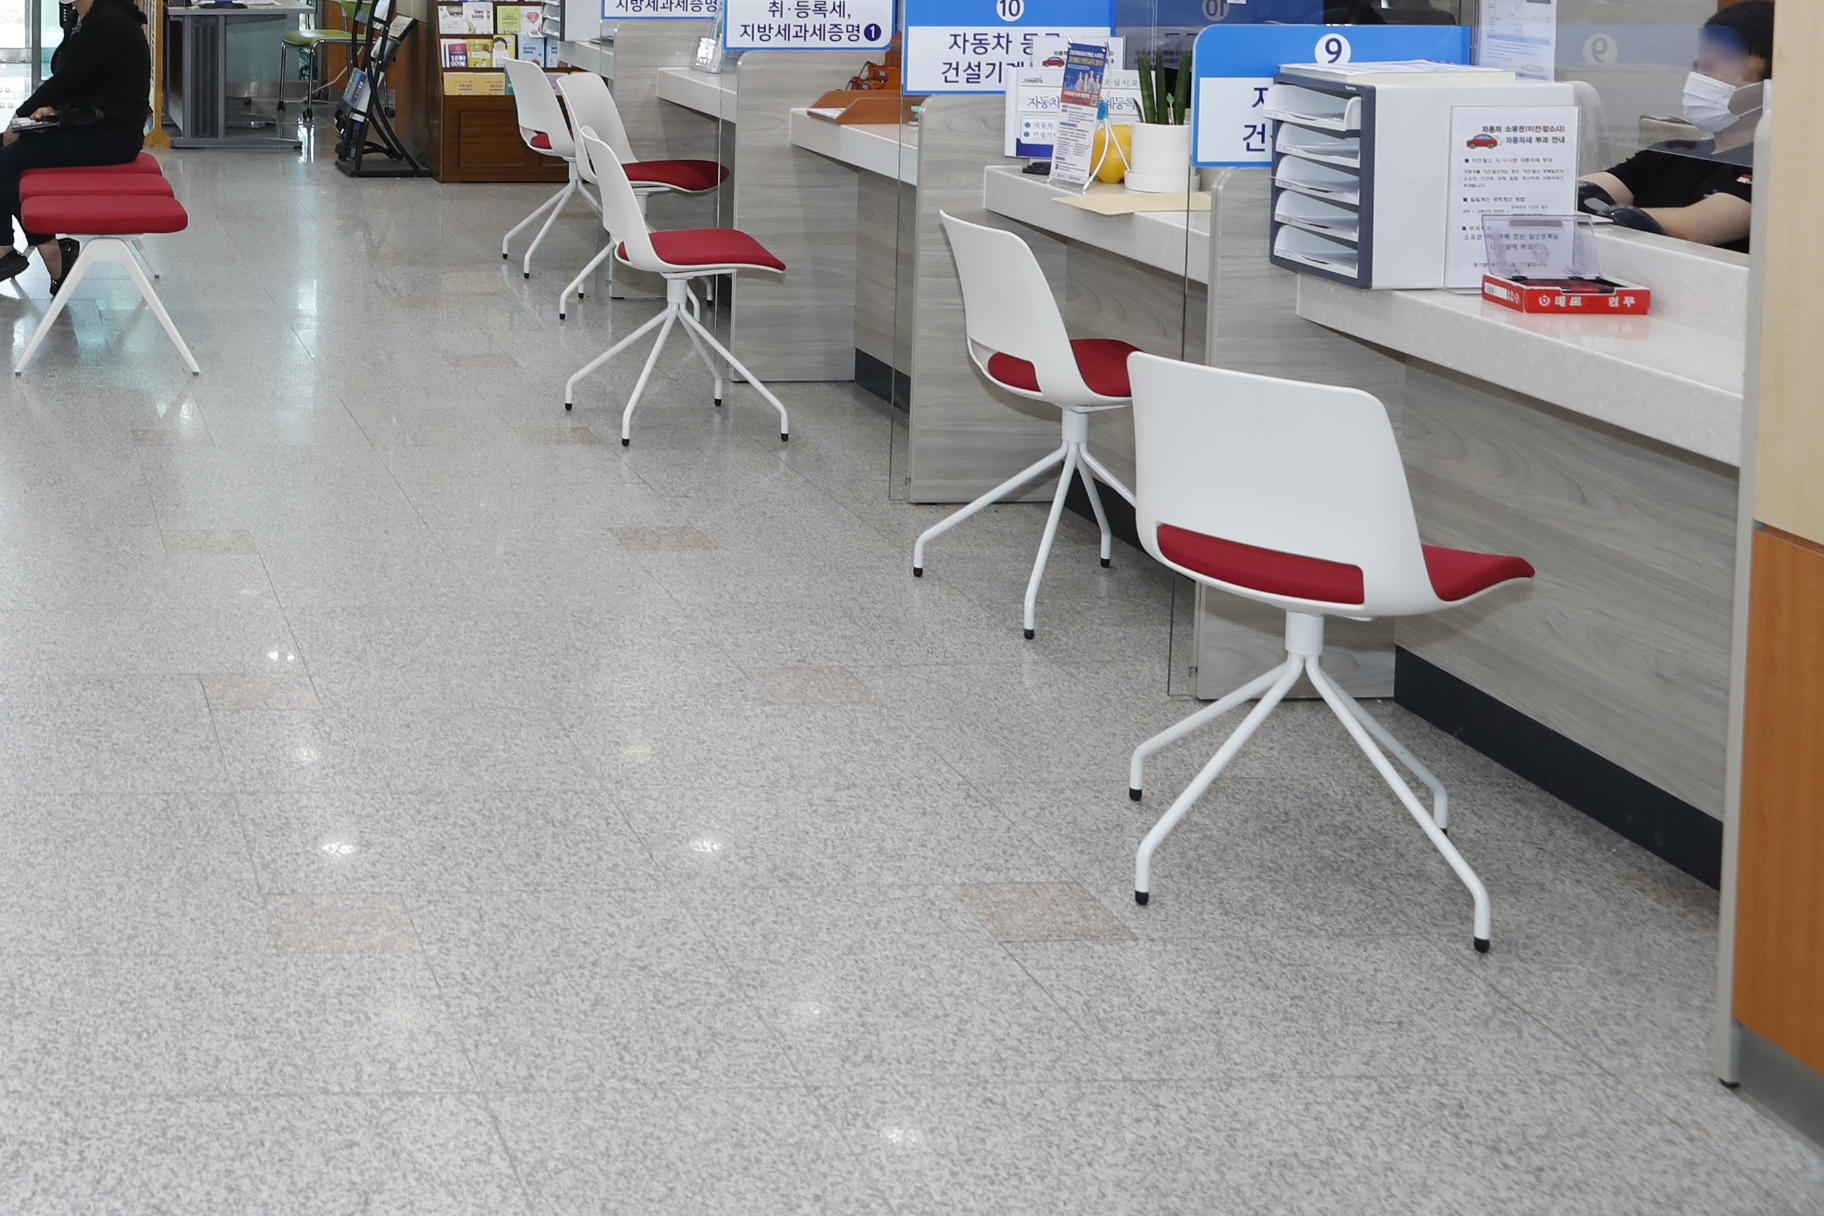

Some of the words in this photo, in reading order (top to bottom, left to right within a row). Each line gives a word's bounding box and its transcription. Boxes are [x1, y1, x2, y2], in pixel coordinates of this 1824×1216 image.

[768, 0, 851, 20] 취·등록세,
[740, 23, 860, 42] 지방세과세증명
[948, 32, 1012, 55] 자동차
[1325, 38, 1342, 63] 9
[941, 62, 1024, 84] 건설기
